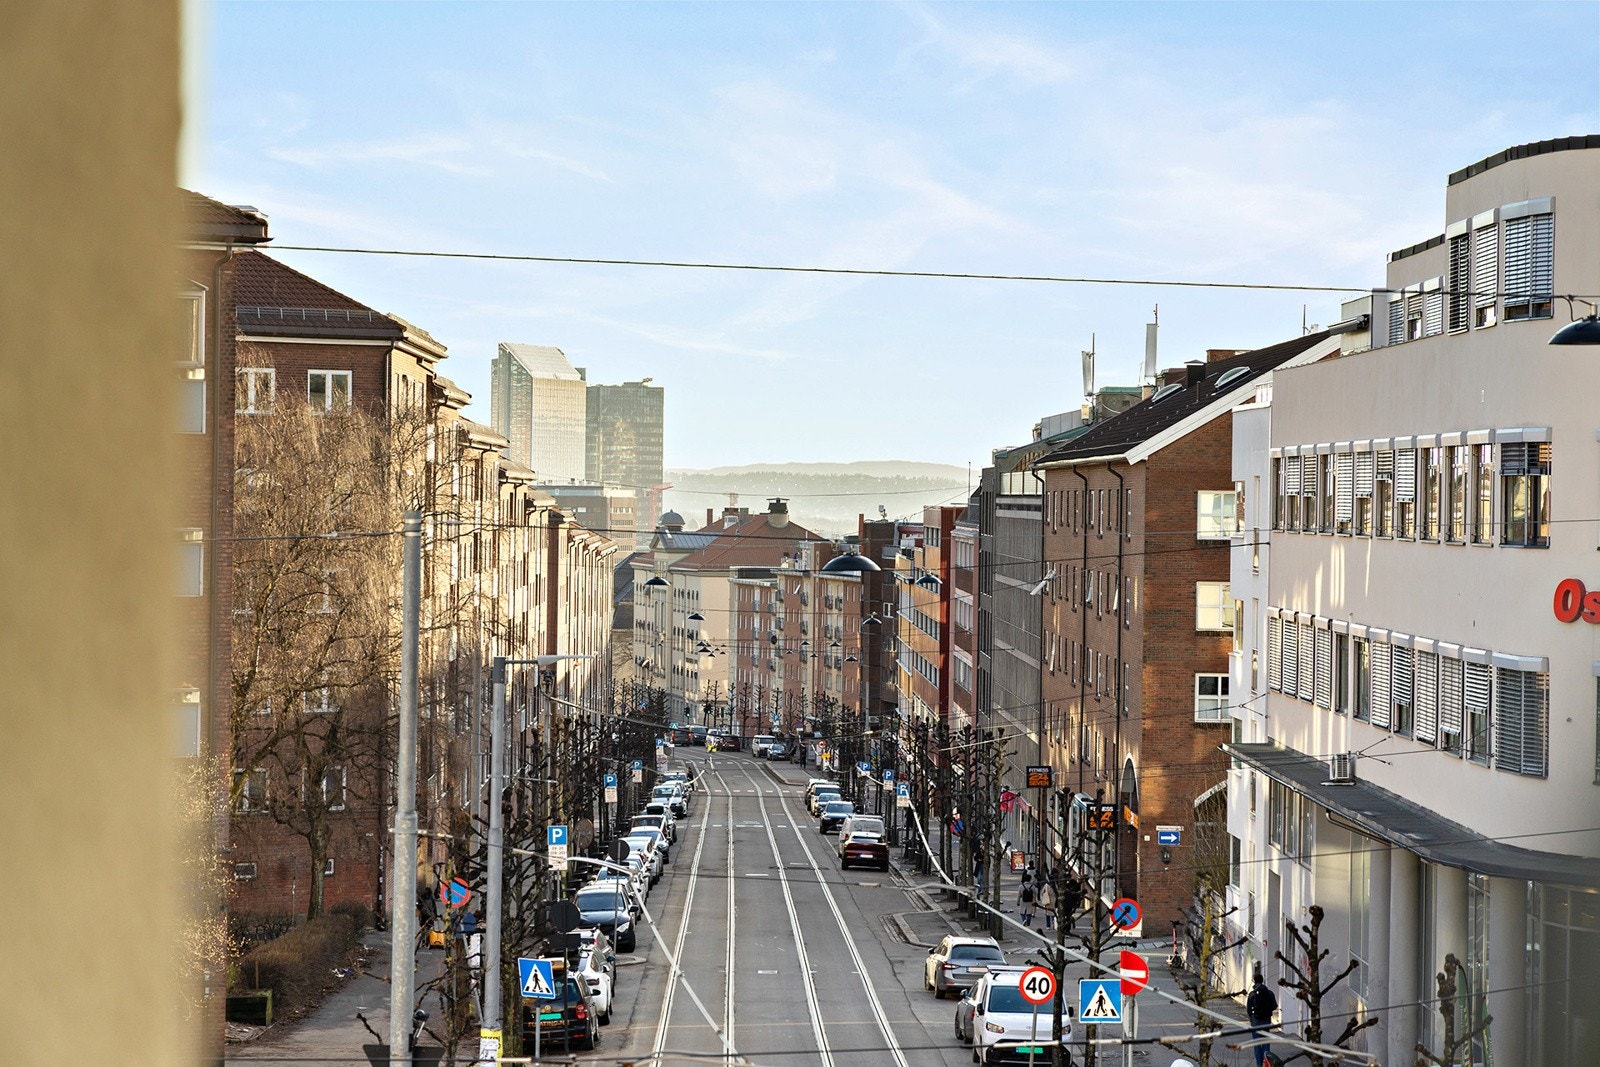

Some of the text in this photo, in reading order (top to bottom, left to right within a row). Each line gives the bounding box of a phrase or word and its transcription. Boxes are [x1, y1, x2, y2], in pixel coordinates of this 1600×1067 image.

[1553, 578, 1600, 624] Os
[552, 828, 563, 843] P
[1026, 977, 1050, 995] 40
